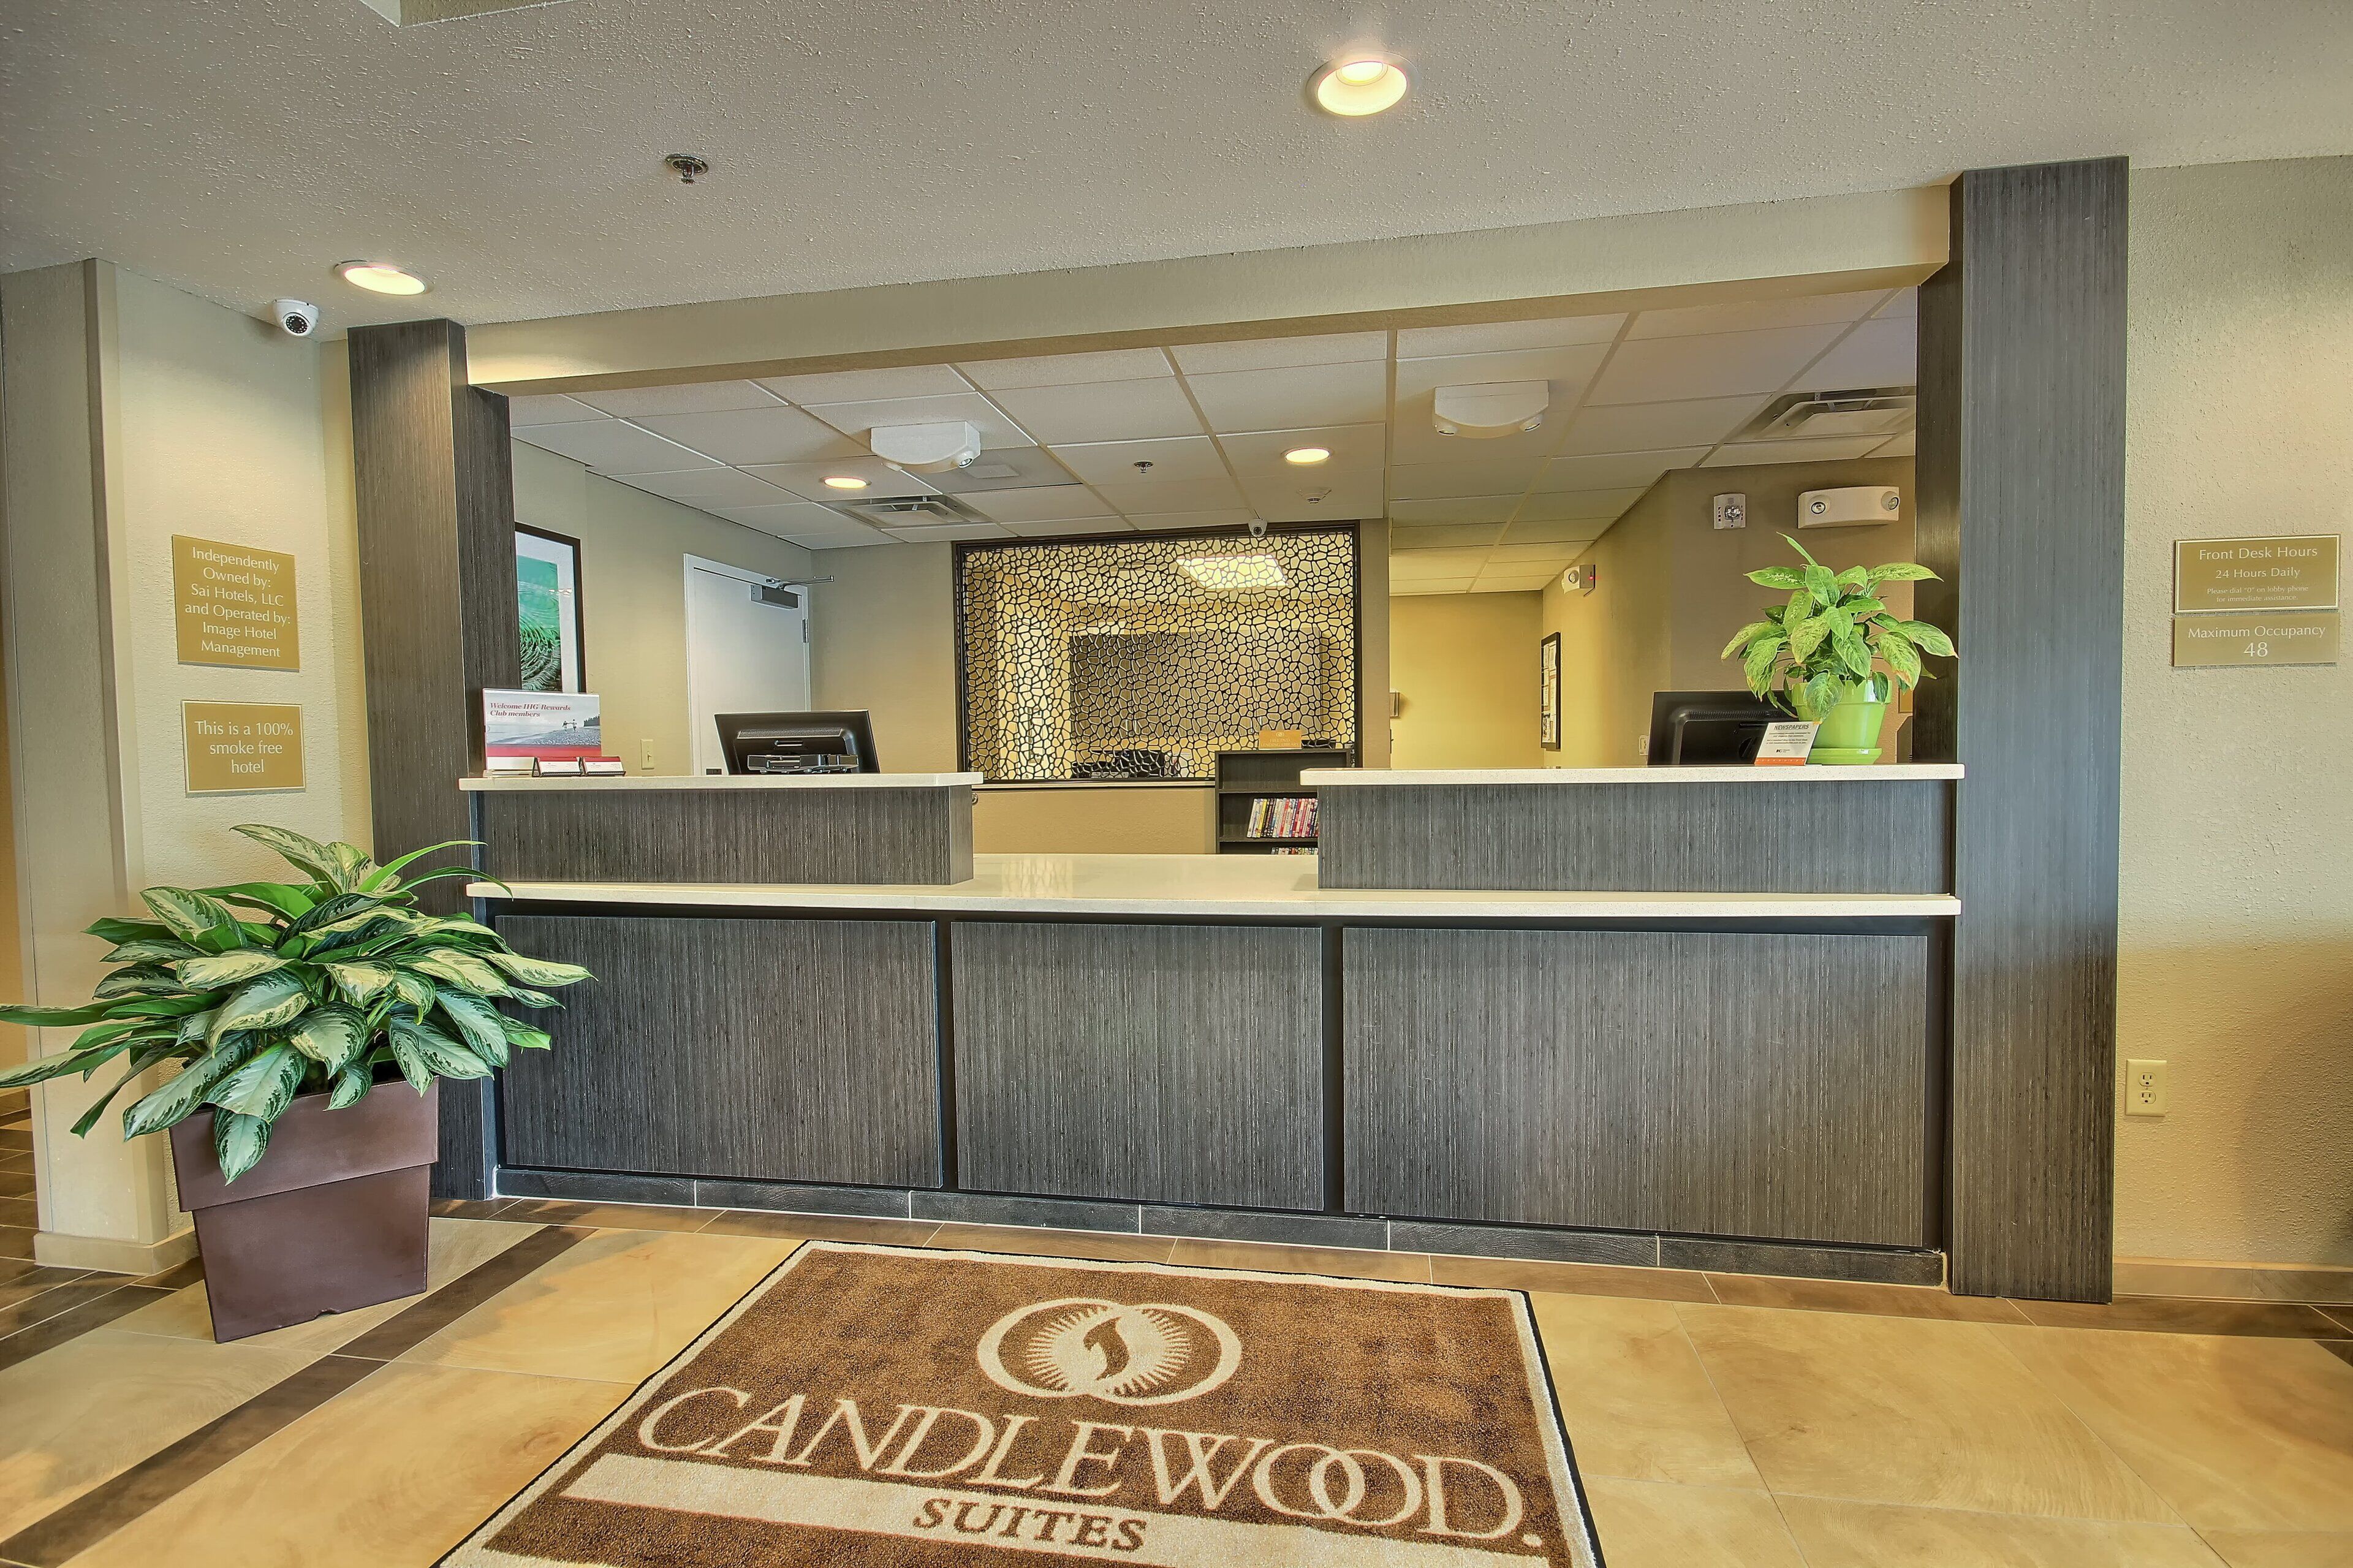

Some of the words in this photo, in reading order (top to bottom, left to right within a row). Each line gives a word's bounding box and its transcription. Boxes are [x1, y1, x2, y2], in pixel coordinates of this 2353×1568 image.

[192, 547, 279, 574] Independently
[2199, 549, 2234, 560] Front
[2238, 547, 2272, 559] Desk
[2277, 546, 2318, 558] Hours
[203, 567, 249, 585] Owned
[253, 573, 271, 588] by:
[2216, 570, 2230, 578] 24
[2234, 569, 2267, 578] Hours
[2271, 567, 2300, 578] Daily
[191, 584, 210, 597] Sai
[214, 588, 257, 604] Hotels,
[261, 594, 284, 607] LLC
[185, 604, 209, 615] and
[213, 605, 270, 624] Operated
[273, 613, 291, 627] by:
[203, 622, 241, 639] Image
[245, 626, 277, 640] Hotel
[2188, 627, 2250, 638] Maximum
[2254, 626, 2326, 639] Occupancy
[202, 641, 281, 658] Management
[2243, 642, 2268, 657] 48
[195, 721, 224, 735] This
[229, 722, 238, 735] is
[243, 725, 251, 735] a
[256, 722, 294, 735] 100%
[210, 740, 254, 754] smoke
[258, 740, 283, 755] free
[231, 758, 265, 773] hotel
[912, 1497, 1147, 1553] SUITES
